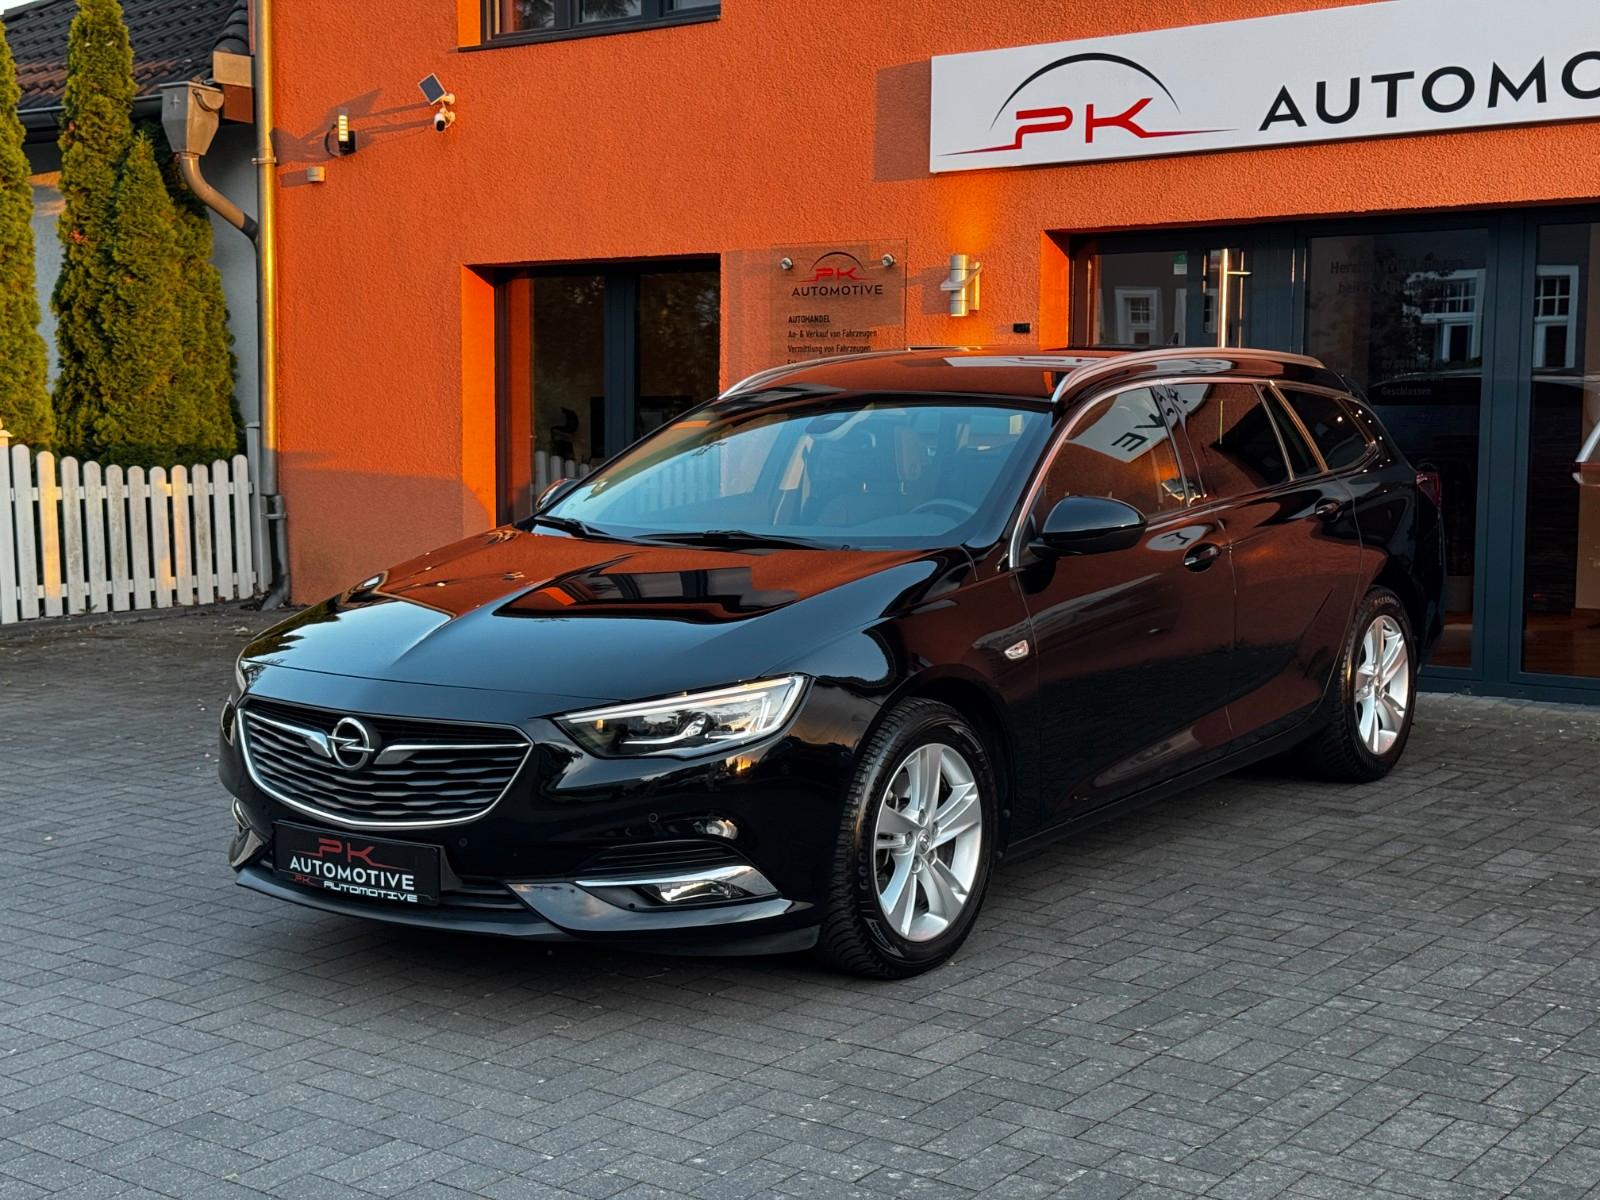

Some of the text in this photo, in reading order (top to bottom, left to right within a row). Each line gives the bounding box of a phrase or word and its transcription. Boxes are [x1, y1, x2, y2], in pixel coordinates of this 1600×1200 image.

[1257, 51, 1600, 131] AUTOMO
[809, 266, 864, 282] PK
[791, 284, 883, 297] AUTOMOTIVE
[788, 314, 831, 324] AUTOHANDEL
[805, 329, 829, 338] Verkauf
[842, 328, 878, 339] Fahrzeugen
[787, 343, 872, 354] Vermittlung von Fahrzeugen
[289, 855, 415, 891] AUTOMOTIVE
[323, 880, 418, 903] AUTOMOTIVE
